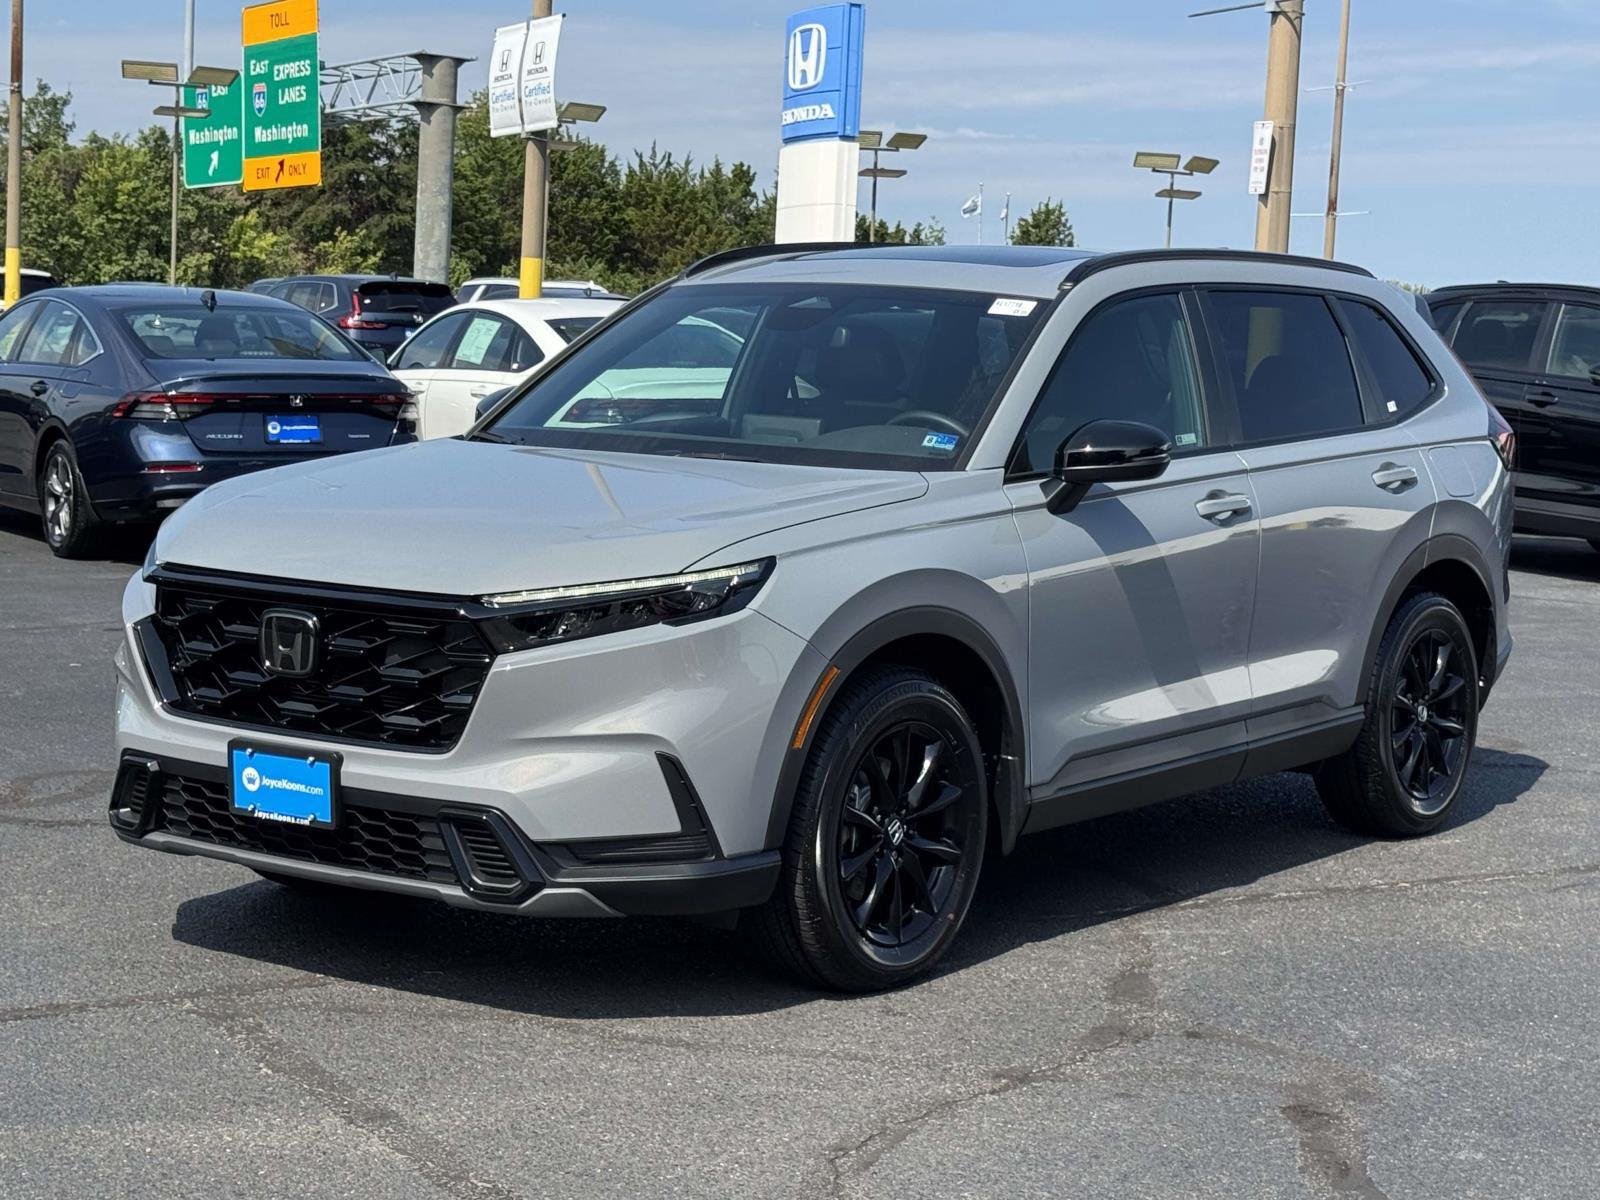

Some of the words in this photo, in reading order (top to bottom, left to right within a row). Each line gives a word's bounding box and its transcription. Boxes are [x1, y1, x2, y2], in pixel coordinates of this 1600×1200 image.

[270, 12, 290, 27] TOLL
[250, 60, 269, 76] EAST
[273, 60, 311, 81] EXPRESS
[527, 66, 548, 76] HONDA
[494, 73, 513, 83] HONDA
[278, 85, 306, 105] LANES
[524, 81, 551, 98] Certified
[255, 93, 265, 106] 66
[189, 125, 239, 146] Washington
[254, 122, 309, 144] Washington
[256, 167, 270, 180] EXIT
[288, 163, 307, 176] ONLY
[261, 776, 324, 796] JoyceKoons.com
[254, 809, 310, 826] JoyceKoons.com
